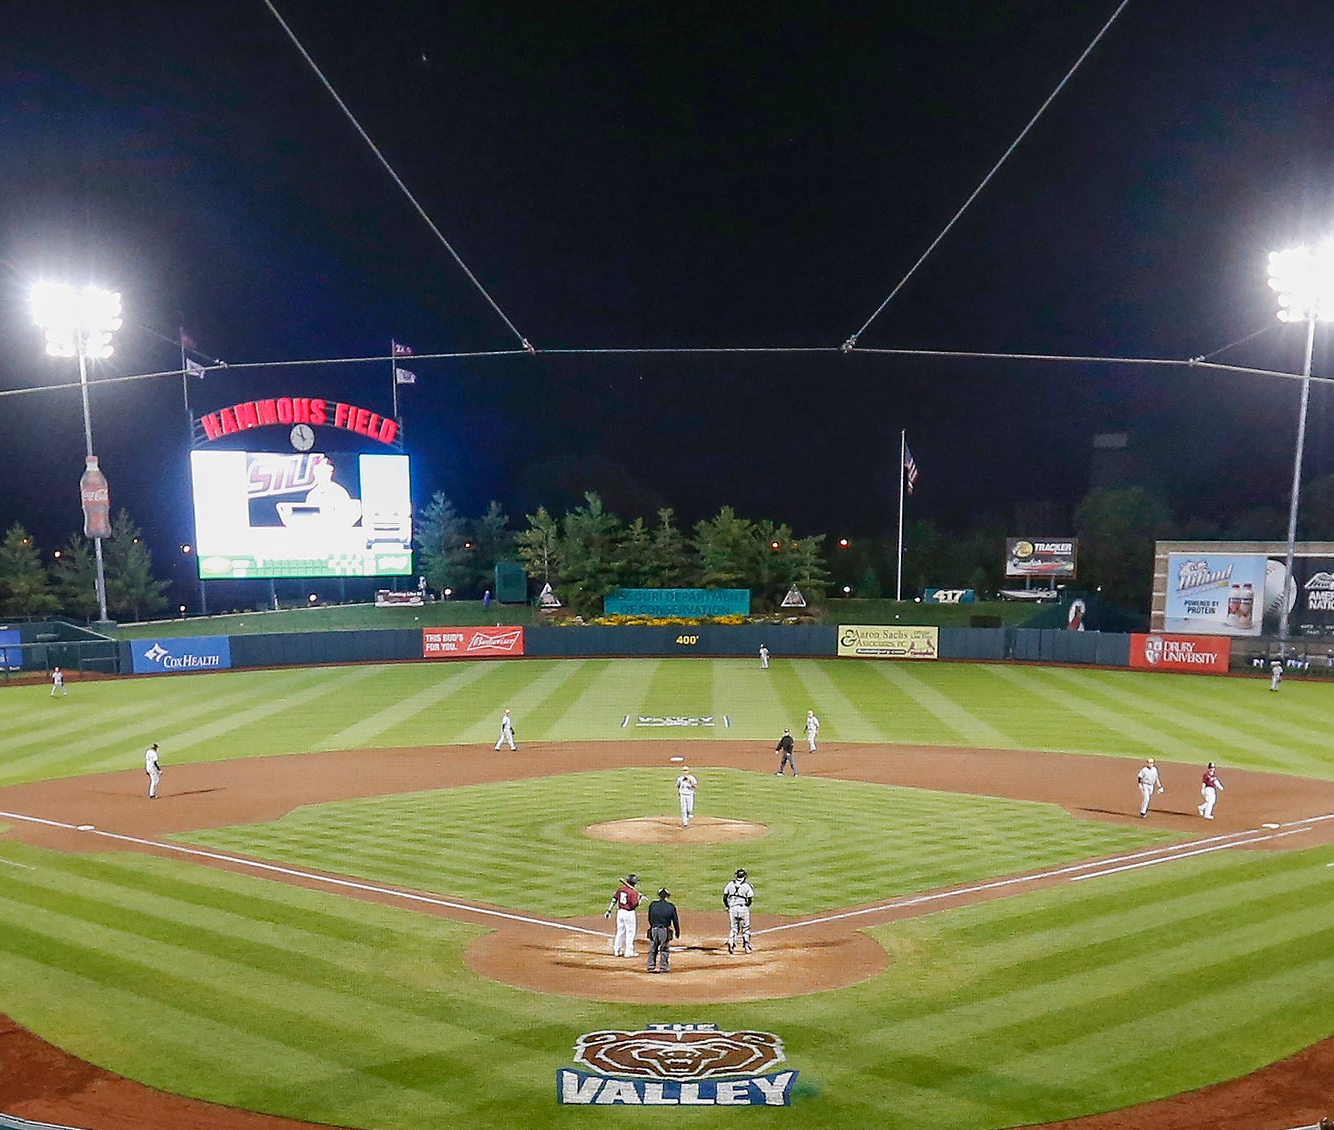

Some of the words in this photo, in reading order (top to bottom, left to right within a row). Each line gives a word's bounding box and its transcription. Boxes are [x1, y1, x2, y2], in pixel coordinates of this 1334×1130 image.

[201, 397, 327, 440] HAMMONS
[334, 403, 398, 444] FIELD
[1034, 542, 1073, 552] TRACKER
[933, 589, 966, 603] 417
[425, 634, 441, 643] THIS
[442, 633, 464, 642] BUD'S
[675, 634, 700, 645] 400'
[883, 629, 908, 639] Sachs
[425, 643, 440, 651] FOR
[442, 643, 458, 651] YOU.
[1164, 641, 1196, 652] DRURY
[1163, 651, 1218, 664] UNIVERSITY
[648, 1023, 717, 1032] THE
[562, 1070, 795, 1106] VALLEY
